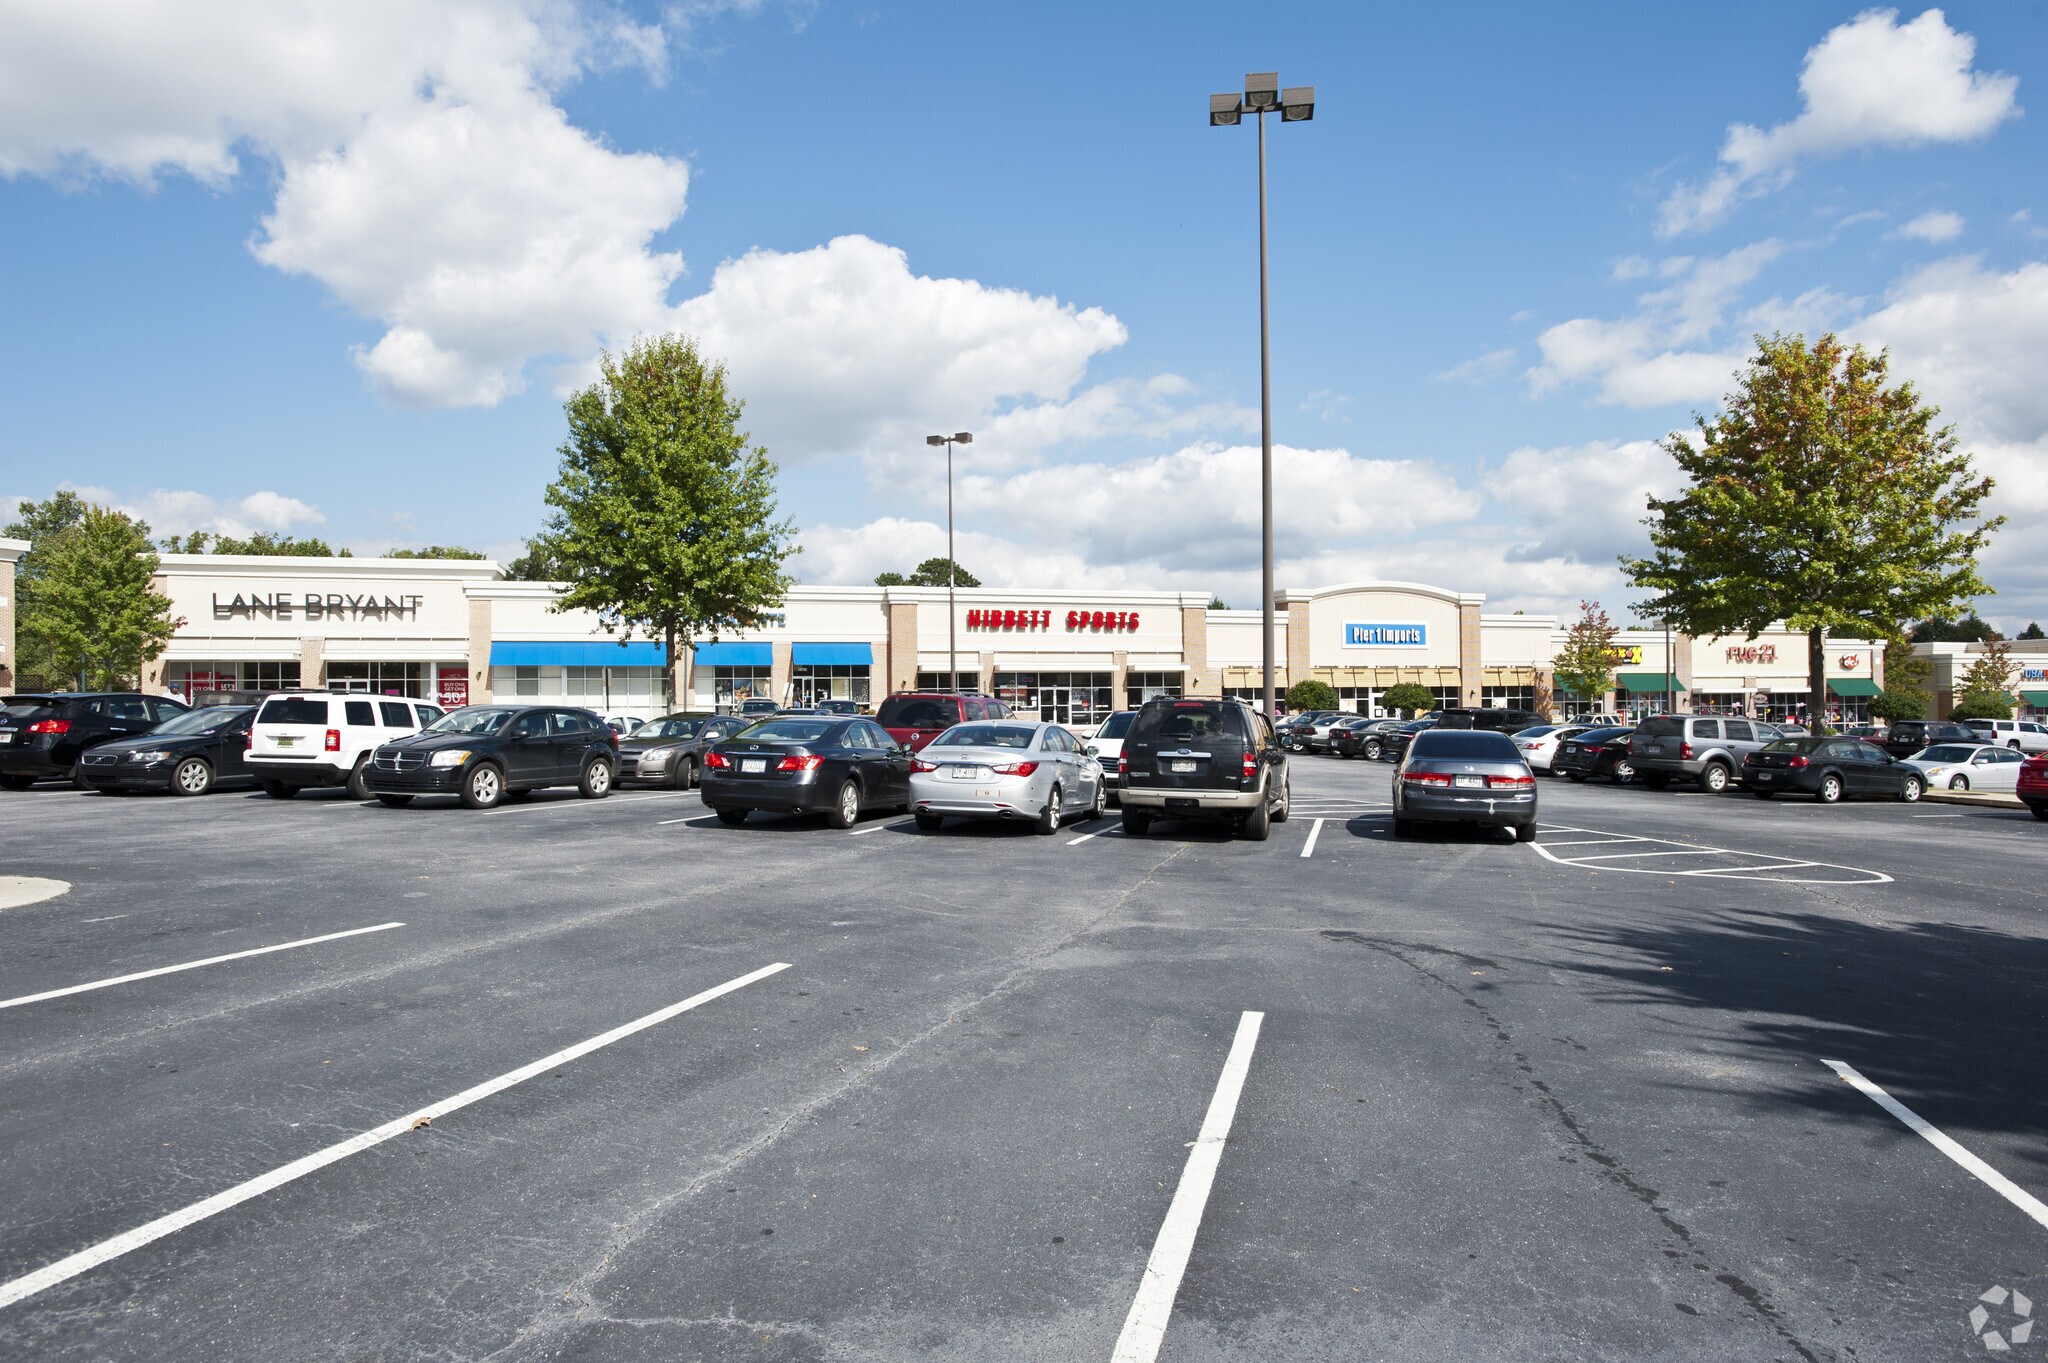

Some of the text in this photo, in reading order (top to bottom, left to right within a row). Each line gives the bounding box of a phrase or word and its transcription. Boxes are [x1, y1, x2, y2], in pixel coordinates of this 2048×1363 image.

[212, 592, 424, 615] LANE BRYANT
[968, 609, 1140, 630] HIBBETT SPORTS
[1353, 627, 1421, 643] Pier 1 Imports
[2025, 669, 2044, 678] USA
